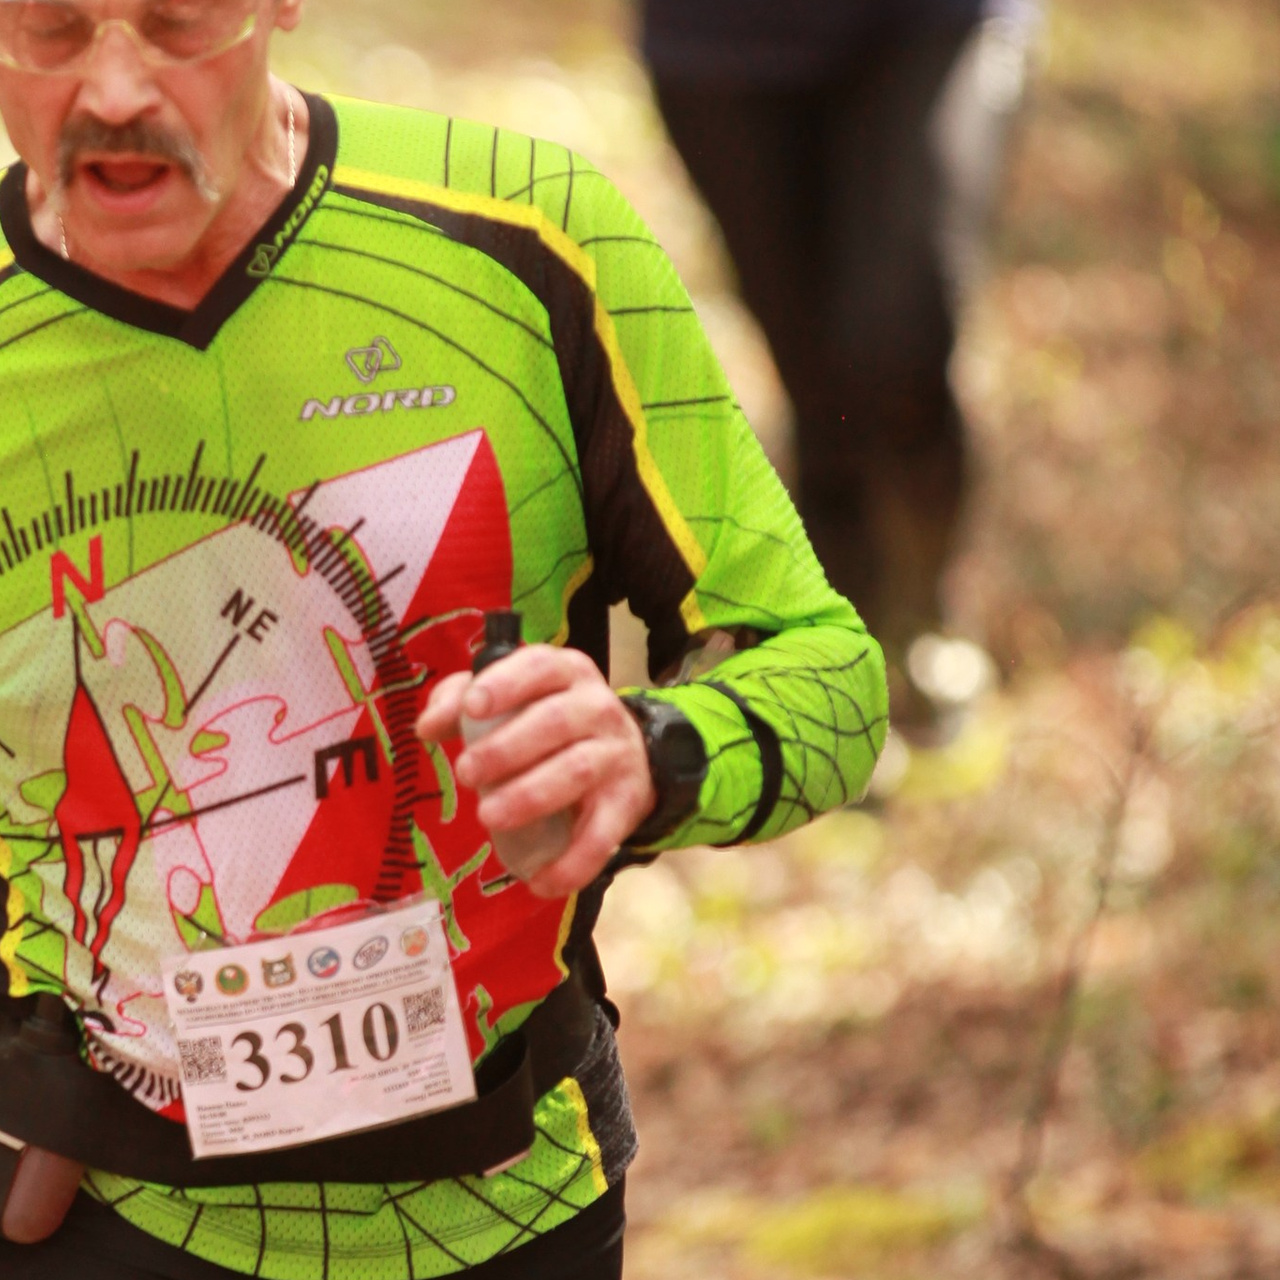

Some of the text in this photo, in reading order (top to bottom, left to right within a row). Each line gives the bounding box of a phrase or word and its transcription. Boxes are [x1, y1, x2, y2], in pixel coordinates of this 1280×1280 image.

[276, 164, 329, 248] NORD
[299, 385, 456, 421] NORD
[50, 535, 105, 619] N
[221, 588, 278, 642] NE
[314, 736, 380, 800] E
[230, 1001, 400, 1093] 3310
